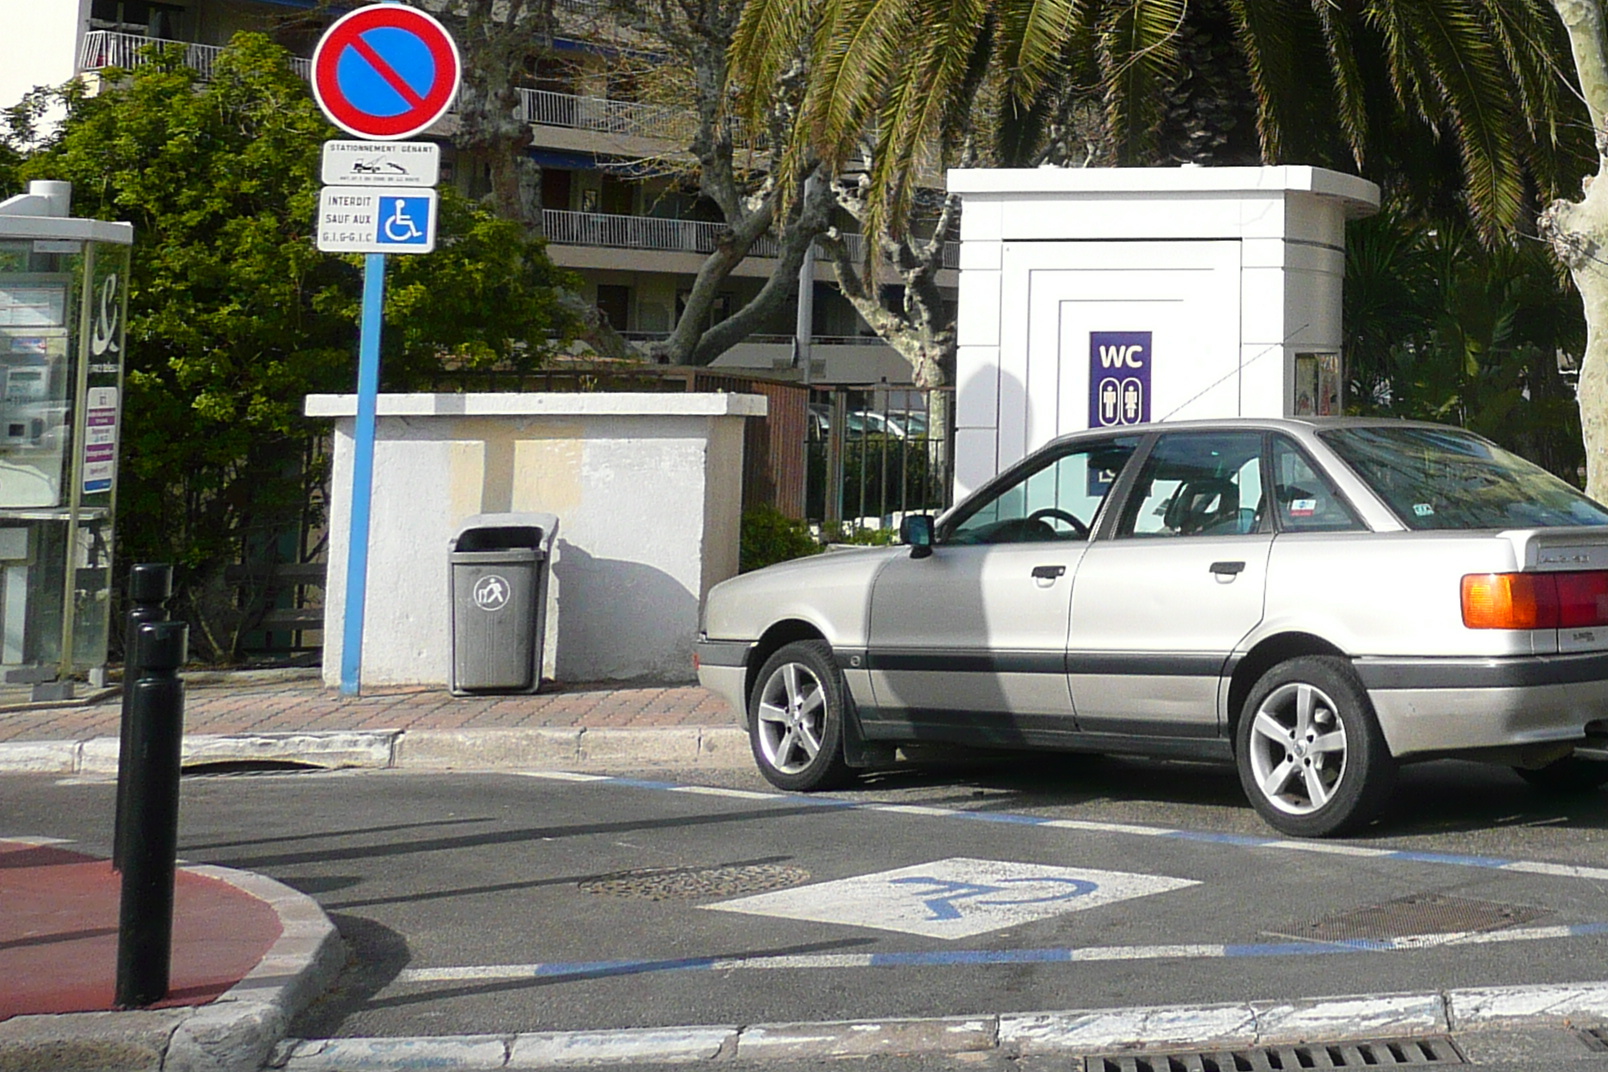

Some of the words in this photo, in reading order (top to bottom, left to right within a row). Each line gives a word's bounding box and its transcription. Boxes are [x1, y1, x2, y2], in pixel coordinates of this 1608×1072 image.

[330, 144, 396, 152] STATIONNEMENT
[328, 196, 372, 206] INTERDIT
[325, 214, 350, 224] SAUF
[352, 214, 371, 224] AUX
[1099, 345, 1143, 368] WC
